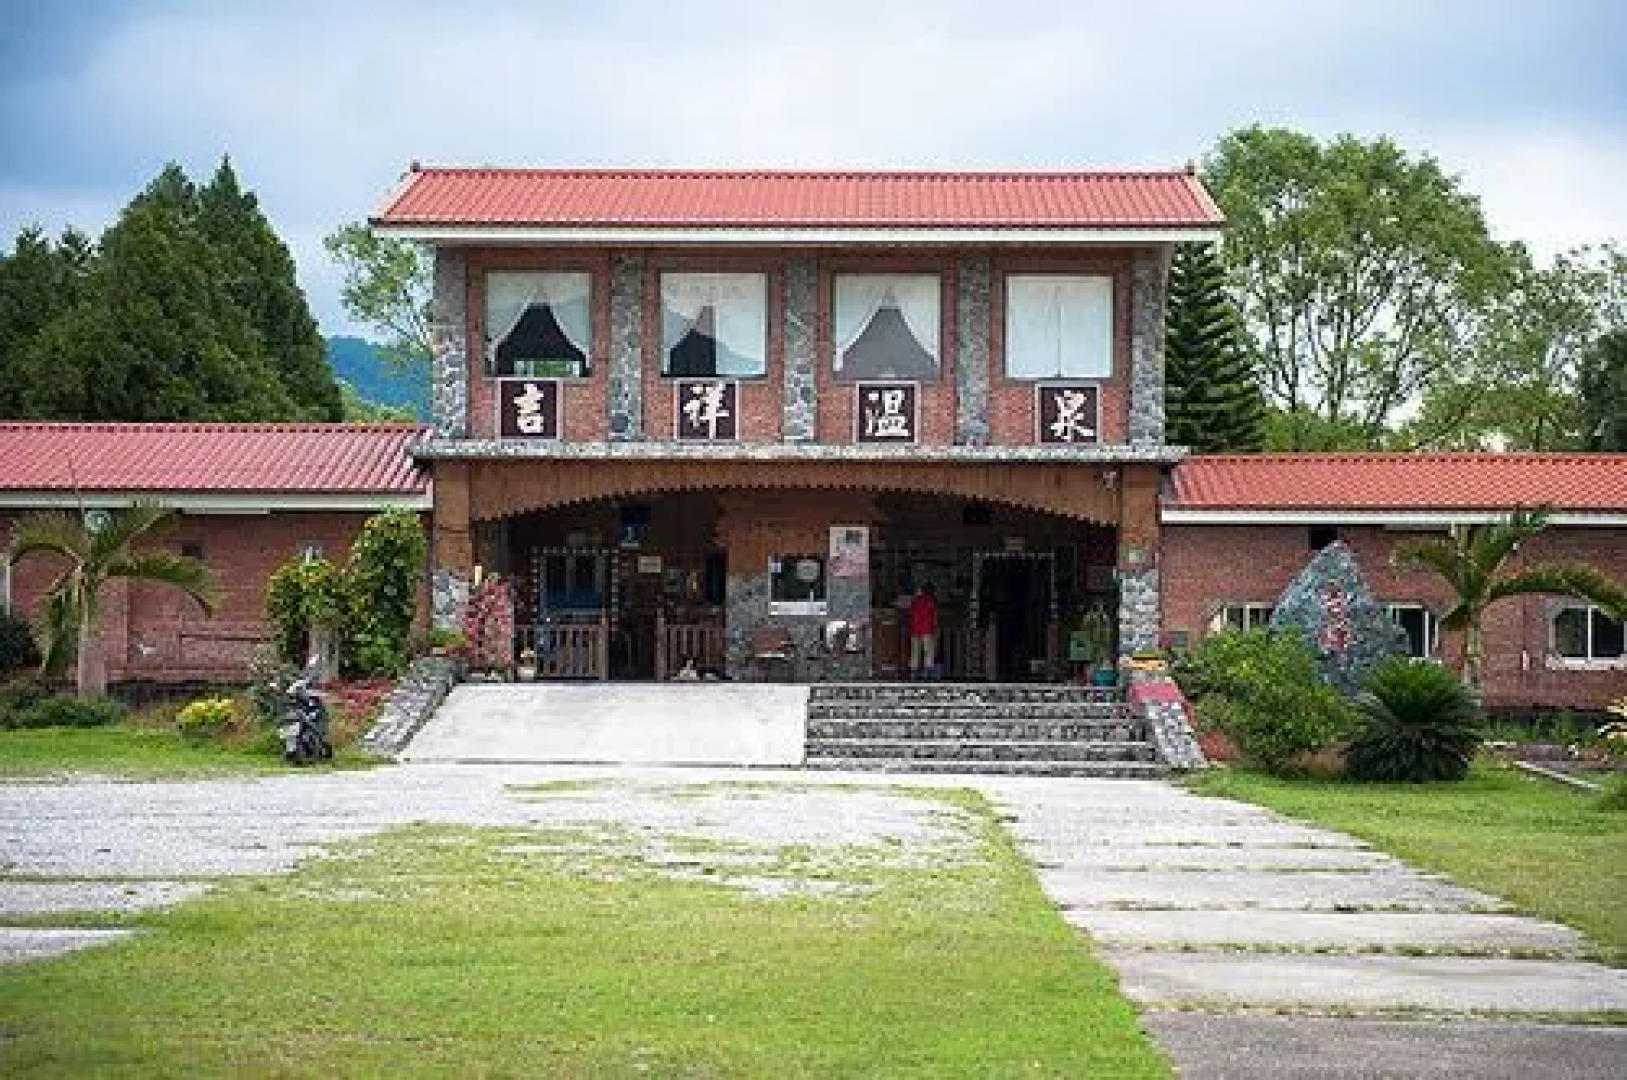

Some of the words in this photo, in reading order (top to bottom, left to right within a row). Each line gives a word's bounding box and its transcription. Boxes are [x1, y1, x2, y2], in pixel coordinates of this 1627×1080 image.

[514, 384, 543, 433] 吉
[683, 382, 729, 439] 祥
[1051, 390, 1093, 440] 泉
